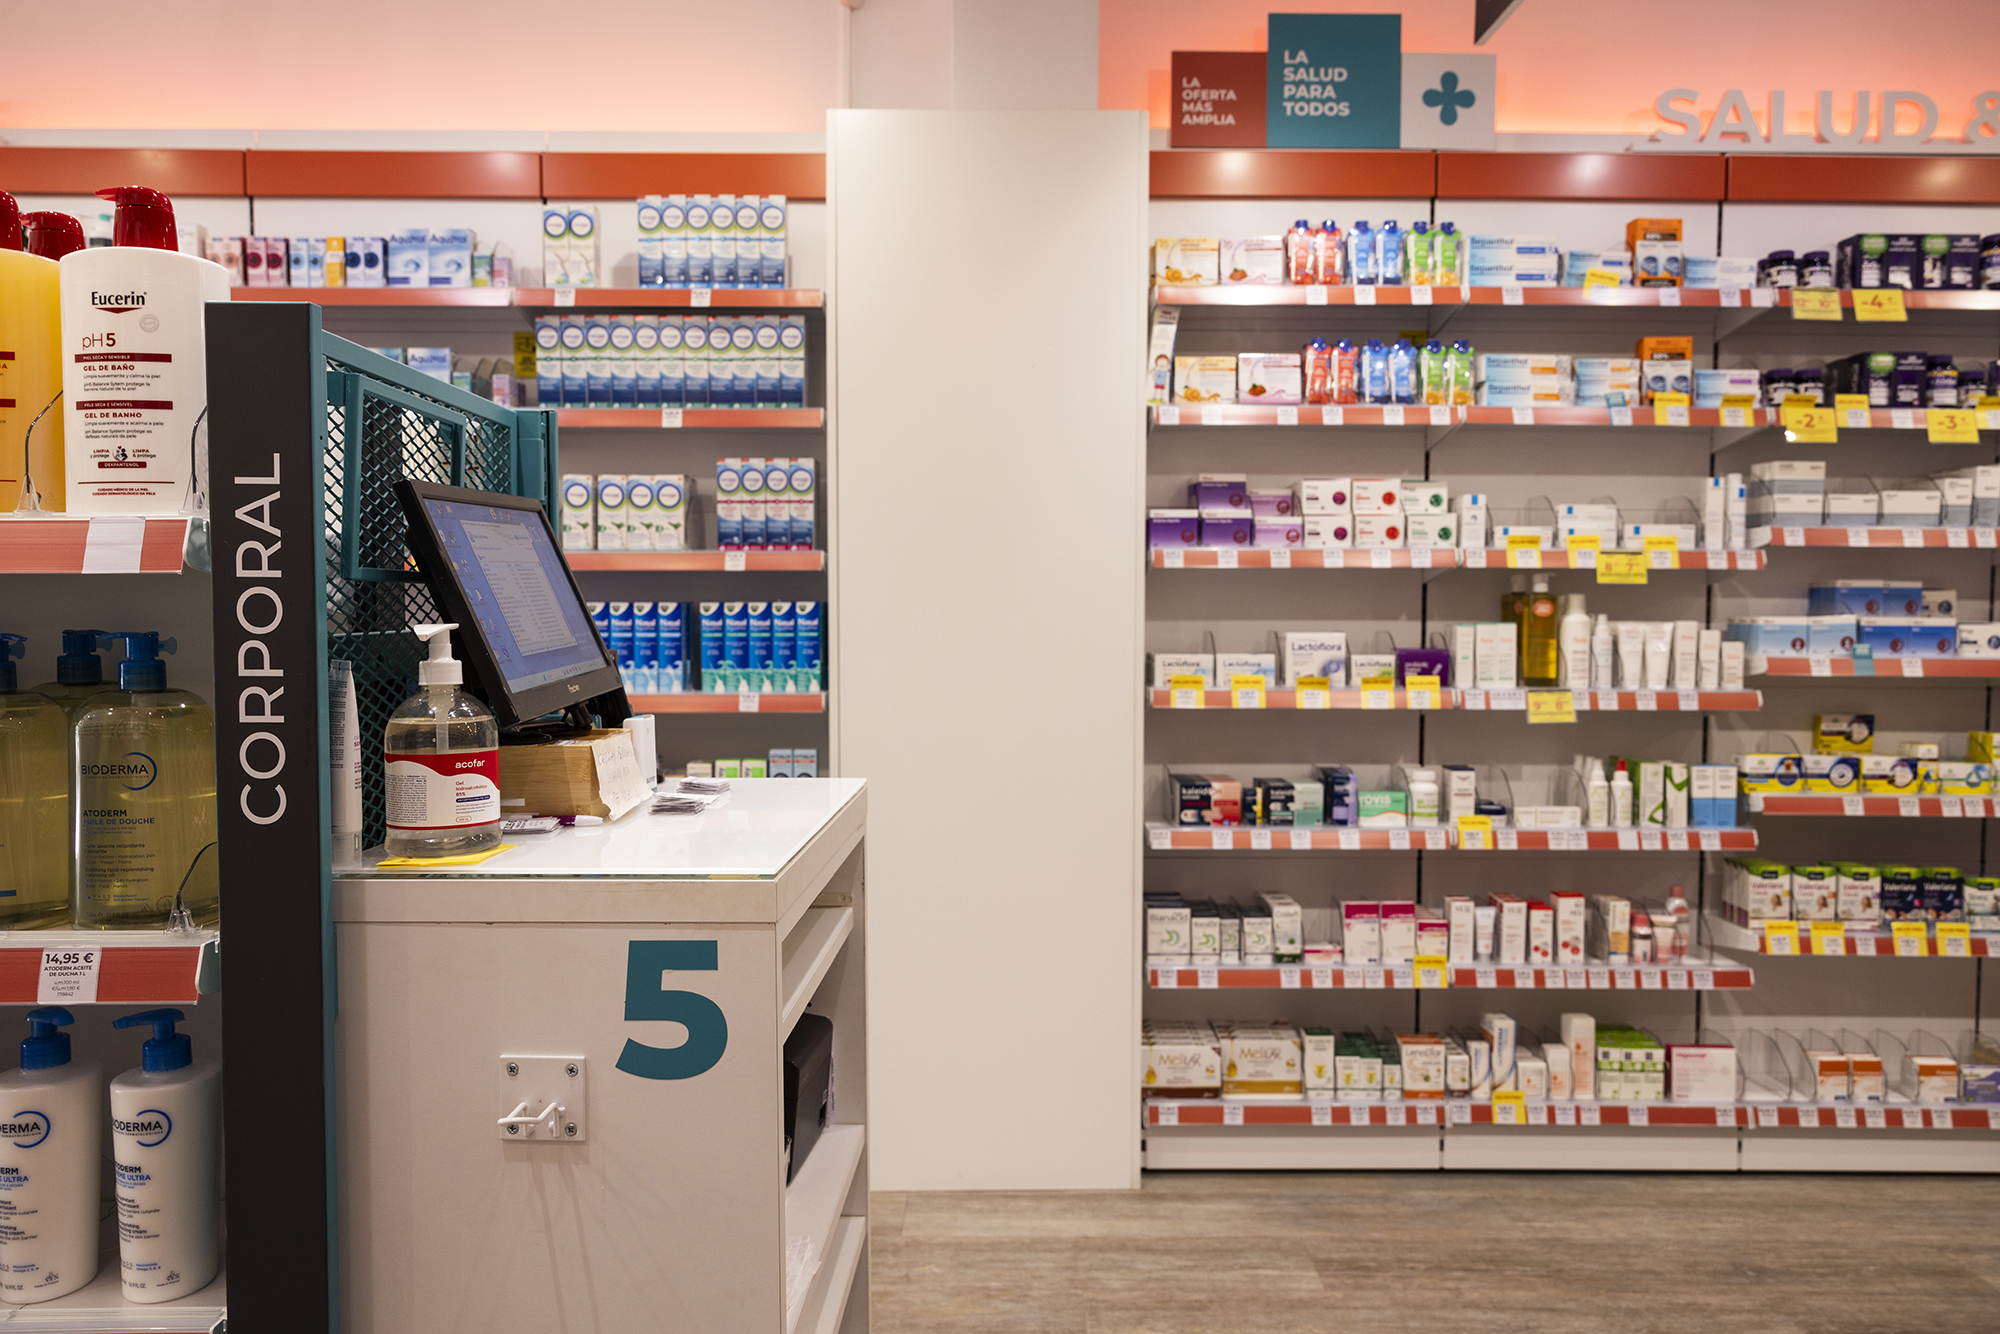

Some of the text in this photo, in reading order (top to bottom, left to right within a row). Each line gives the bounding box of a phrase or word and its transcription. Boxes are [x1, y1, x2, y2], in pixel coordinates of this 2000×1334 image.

[1284, 51, 1308, 64] LA
[1284, 67, 1348, 82] SALUD
[1182, 77, 1200, 88] LA
[1182, 89, 1236, 100] OFERTA
[1284, 85, 1336, 98] PARA
[1182, 101, 1213, 113] MÁS
[1283, 102, 1350, 116] TODOS
[1182, 114, 1236, 125] AMPLIA
[1652, 88, 2000, 145] SALUD &
[91, 291, 145, 305] Eucerin
[234, 452, 287, 825] CORPORAL
[1291, 642, 1342, 652] Lactoflora
[81, 764, 148, 775] BIODERMA
[455, 759, 485, 768] acofar
[83, 809, 127, 817] ATODERM
[119, 817, 155, 825] DOUCHE
[45, 953, 94, 965] 14,95 €
[615, 940, 728, 1080] 5
[112, 1118, 162, 1132] ODERMA
[115, 1161, 141, 1173] ODERM
